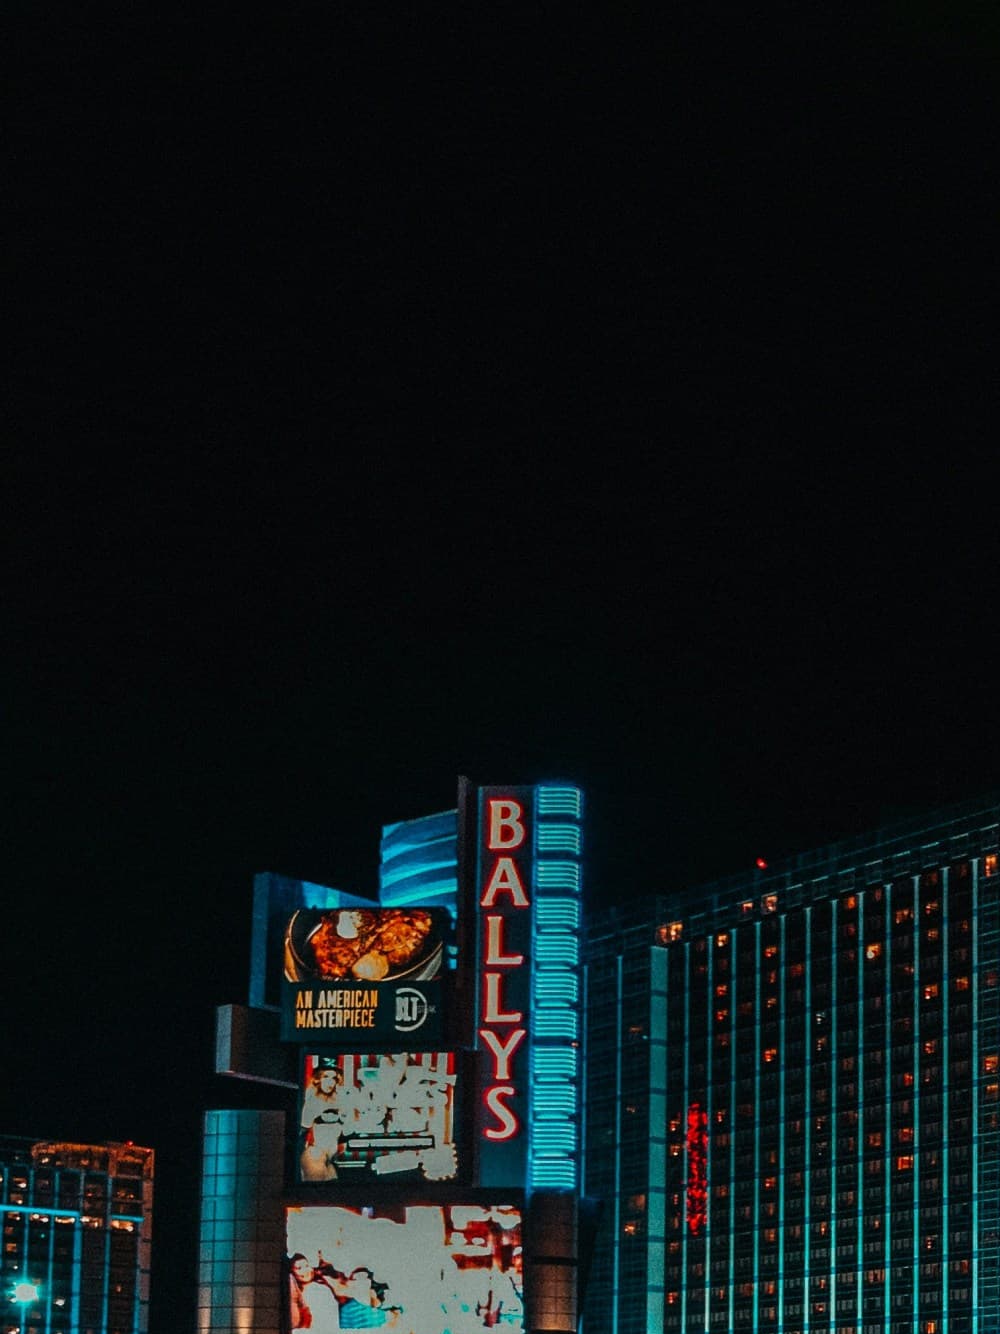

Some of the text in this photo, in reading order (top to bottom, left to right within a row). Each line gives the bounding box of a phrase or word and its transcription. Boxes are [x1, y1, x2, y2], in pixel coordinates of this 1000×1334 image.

[479, 799, 530, 1141] BALLYS
[296, 989, 379, 1008] AN AMERICAN
[296, 1009, 375, 1028] MASTERPIECE
